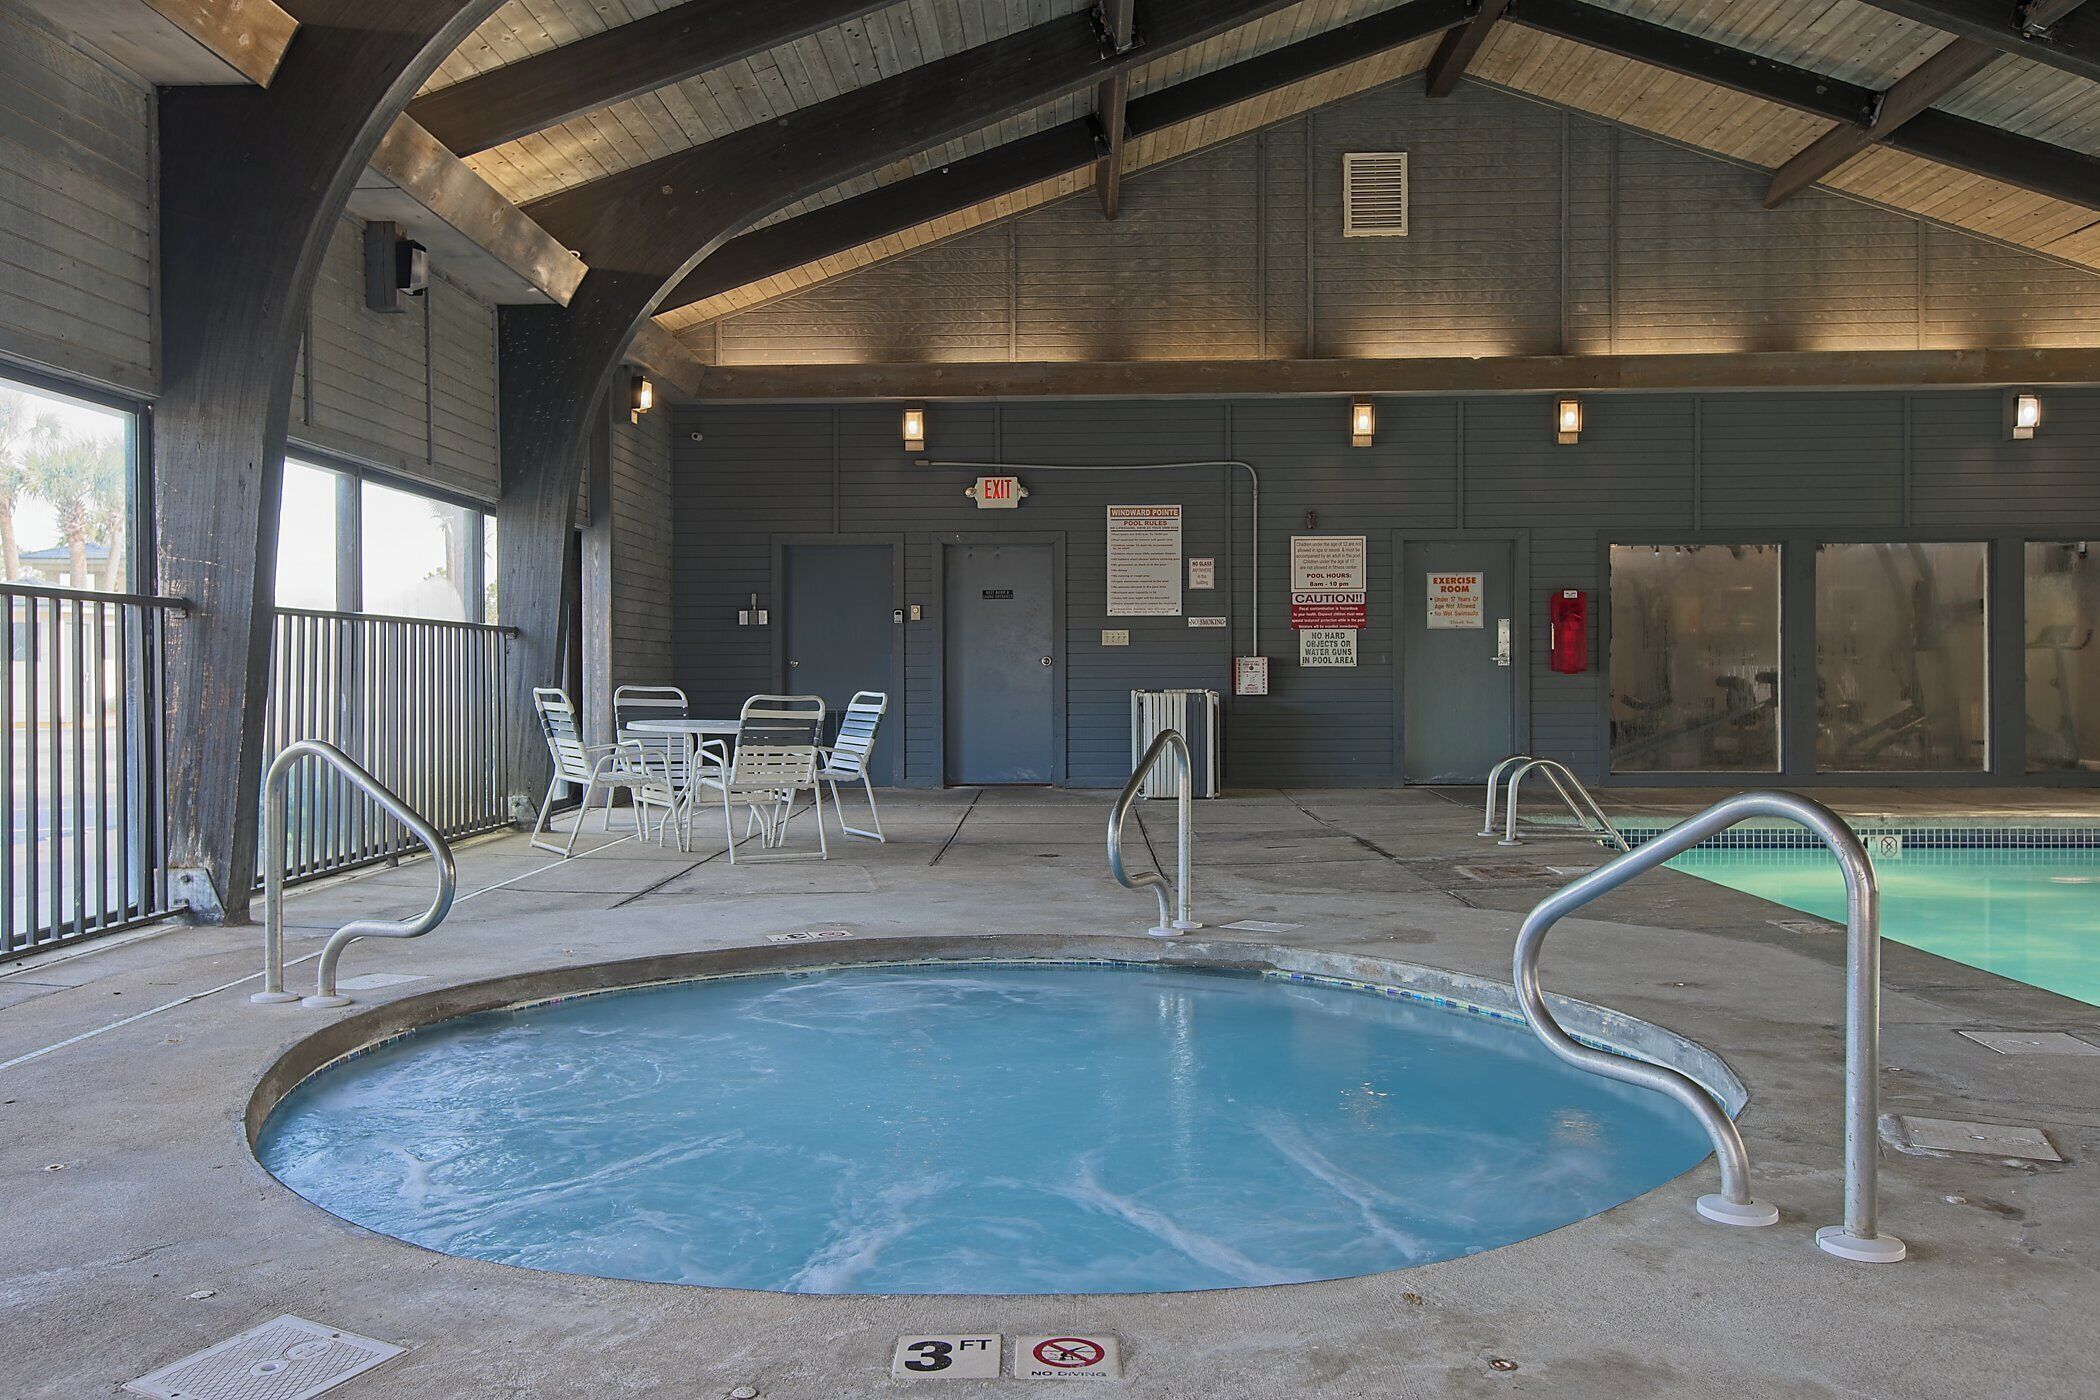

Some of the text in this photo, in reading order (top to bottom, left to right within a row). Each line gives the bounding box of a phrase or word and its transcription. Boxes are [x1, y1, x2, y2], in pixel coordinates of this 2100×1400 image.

[984, 480, 1012, 499] EXIT
[1295, 594, 1362, 604] CAUTION!!
[905, 1339, 992, 1371] 3 FT
